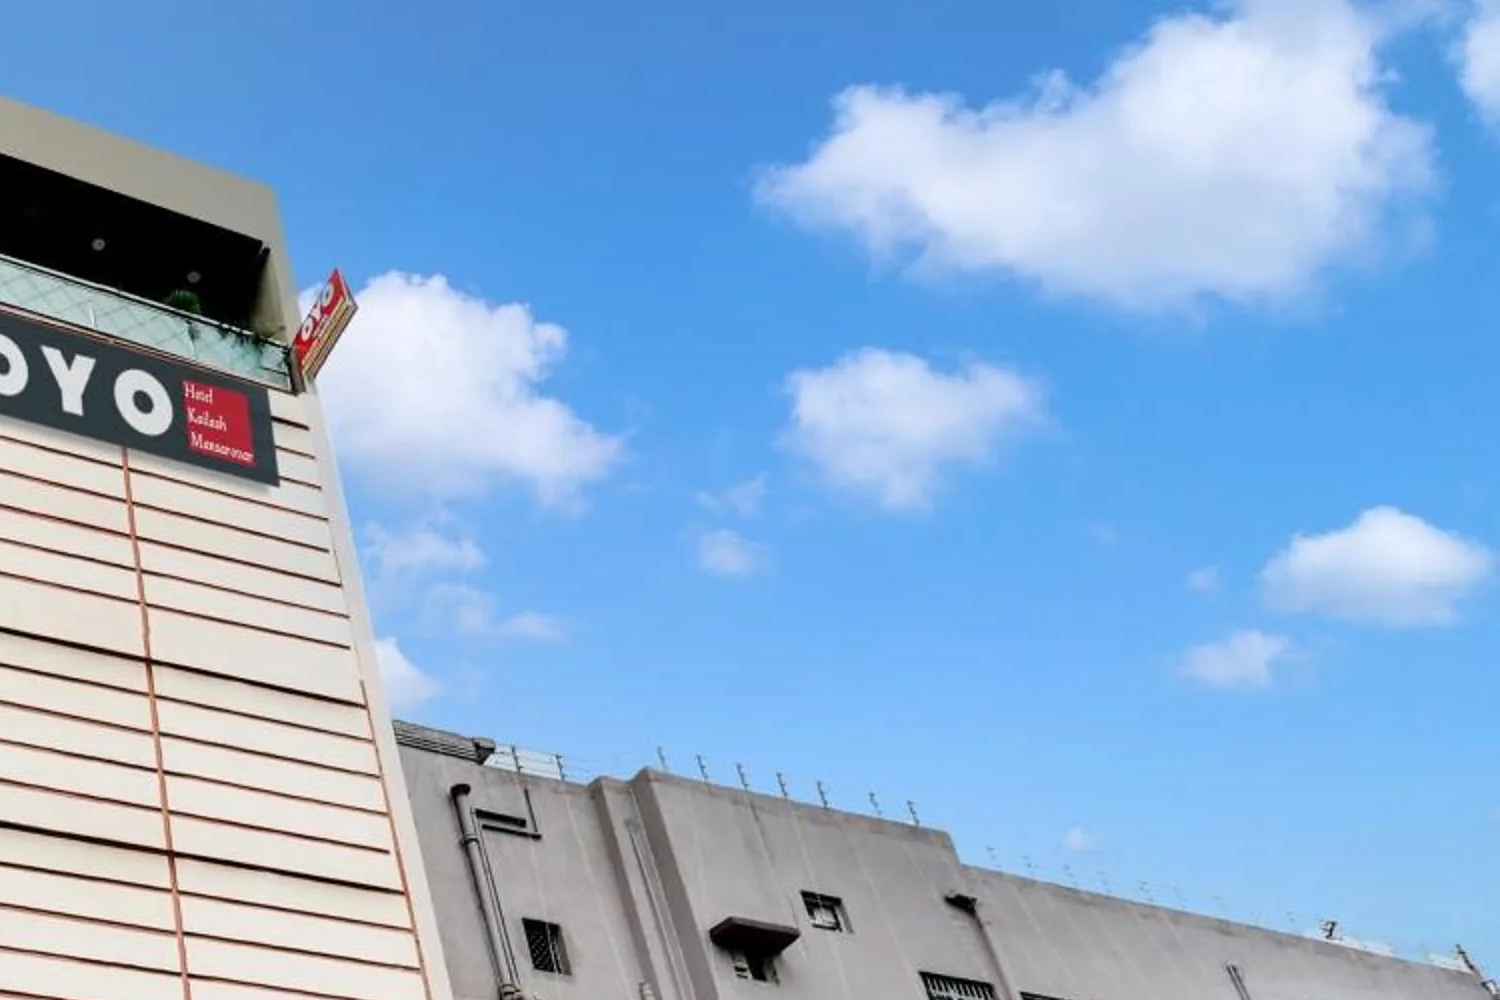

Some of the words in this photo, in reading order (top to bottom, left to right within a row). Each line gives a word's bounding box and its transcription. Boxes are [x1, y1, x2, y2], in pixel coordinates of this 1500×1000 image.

[301, 283, 334, 341] OYO
[183, 382, 213, 404] Hotel
[187, 407, 228, 432] Kailash
